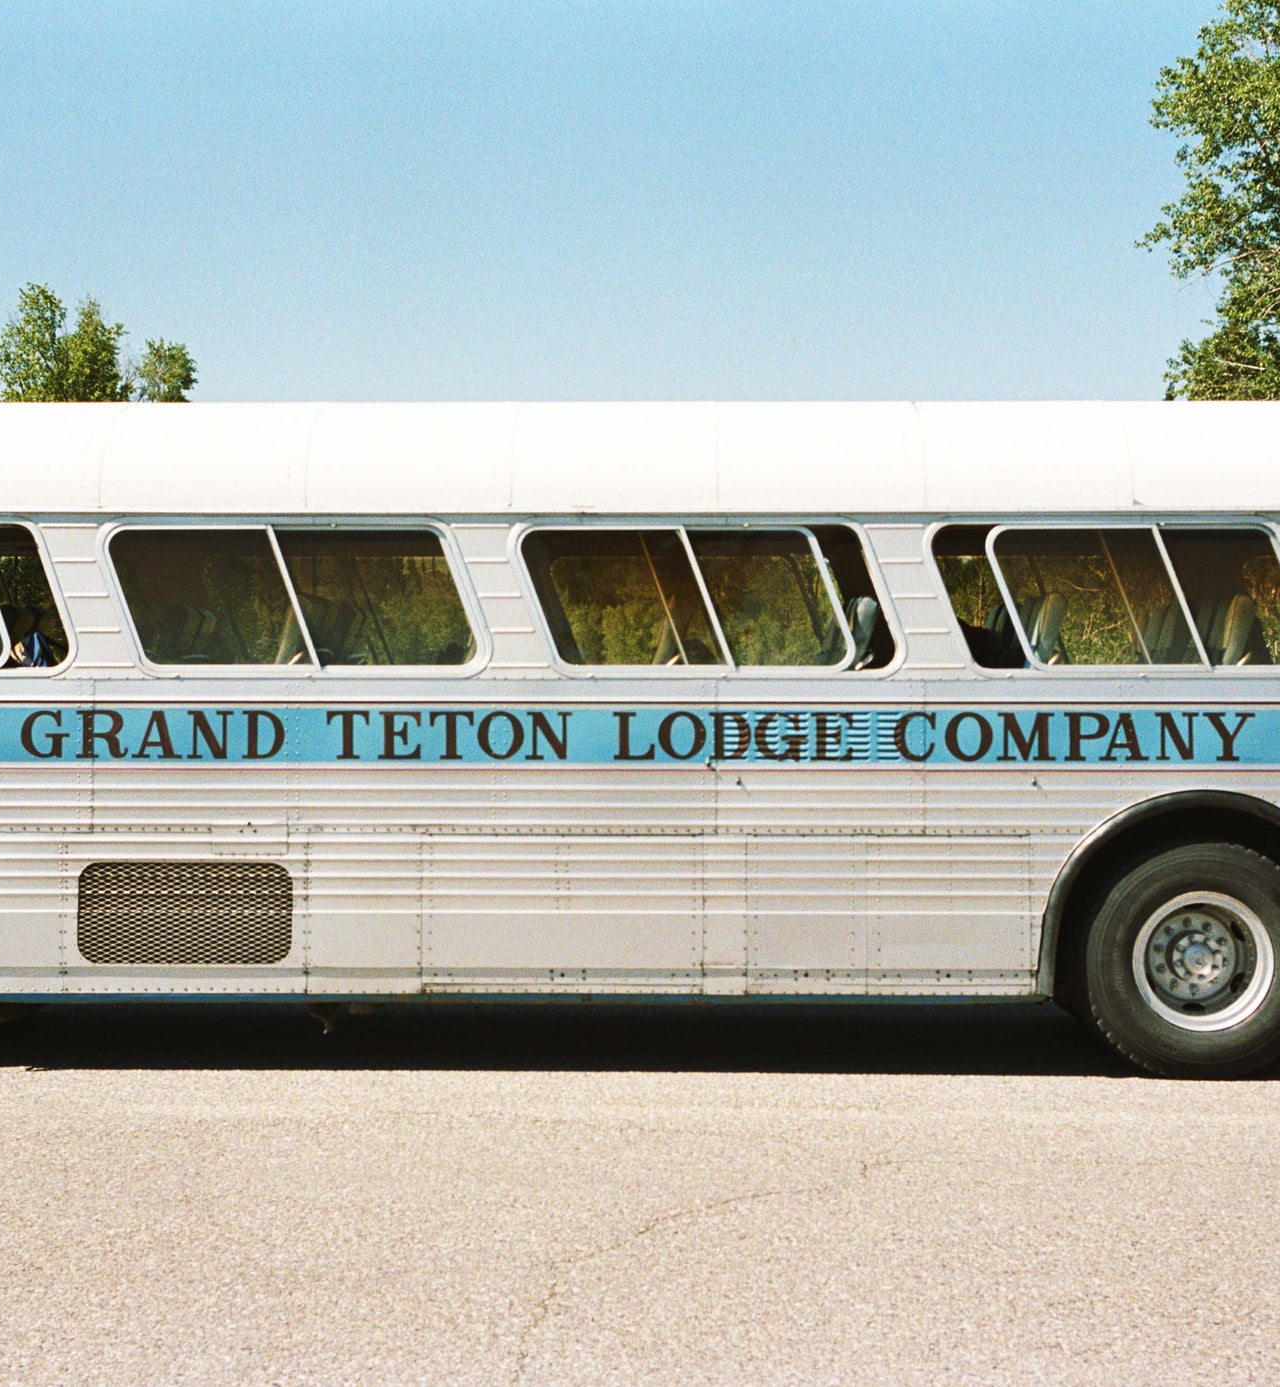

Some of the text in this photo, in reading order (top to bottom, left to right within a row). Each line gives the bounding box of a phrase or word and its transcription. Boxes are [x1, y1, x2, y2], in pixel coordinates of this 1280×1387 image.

[20, 709, 1256, 762] GRAND TETON LODGE COMPANY
